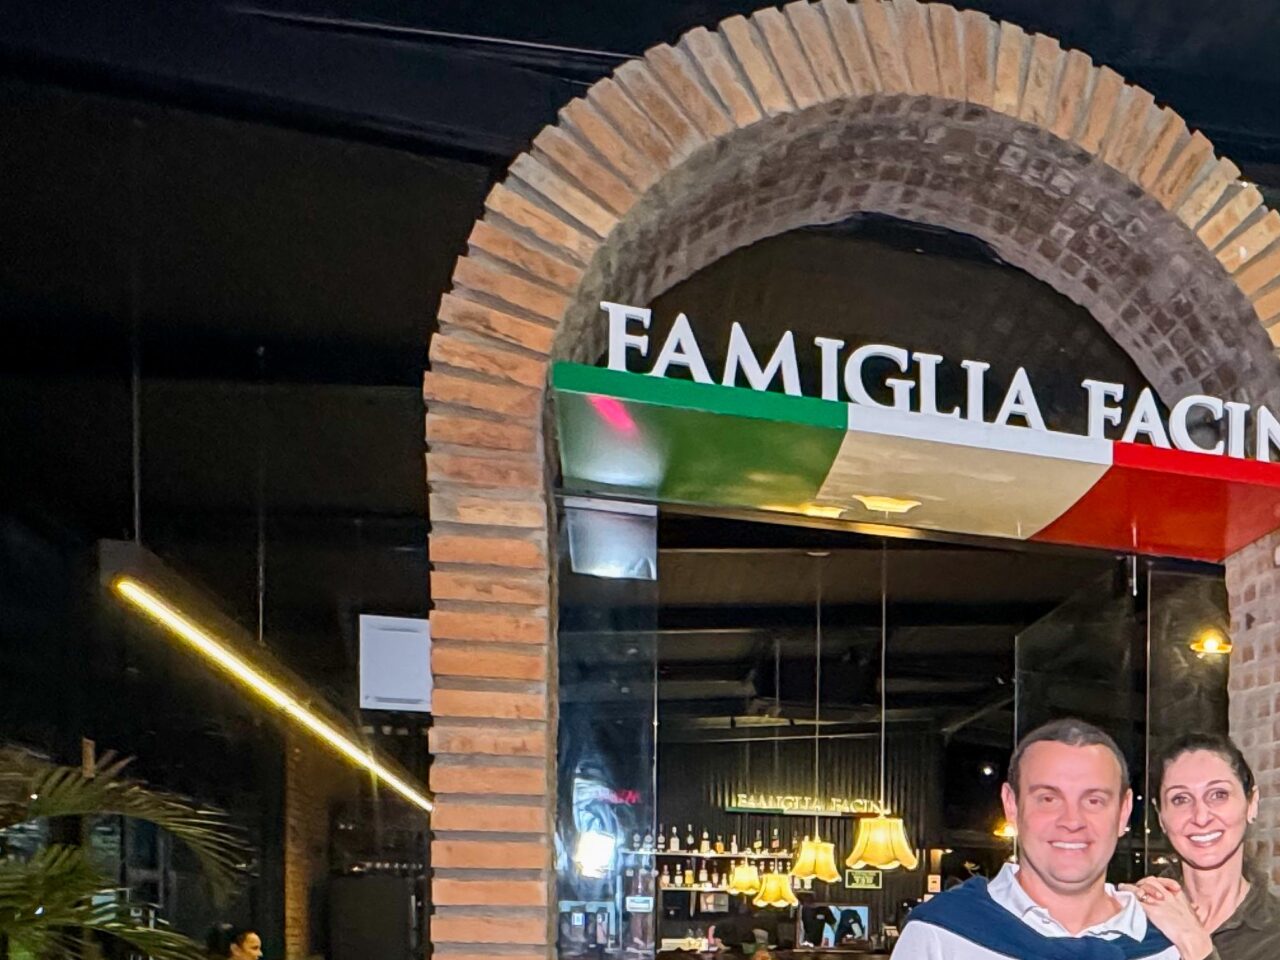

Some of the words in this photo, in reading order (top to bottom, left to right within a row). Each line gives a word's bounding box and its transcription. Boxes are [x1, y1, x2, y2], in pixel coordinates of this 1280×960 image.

[600, 301, 1051, 432] FAMIGLIA
[737, 793, 821, 811] FAMIGLIA
[831, 797, 891, 815] FACIN
